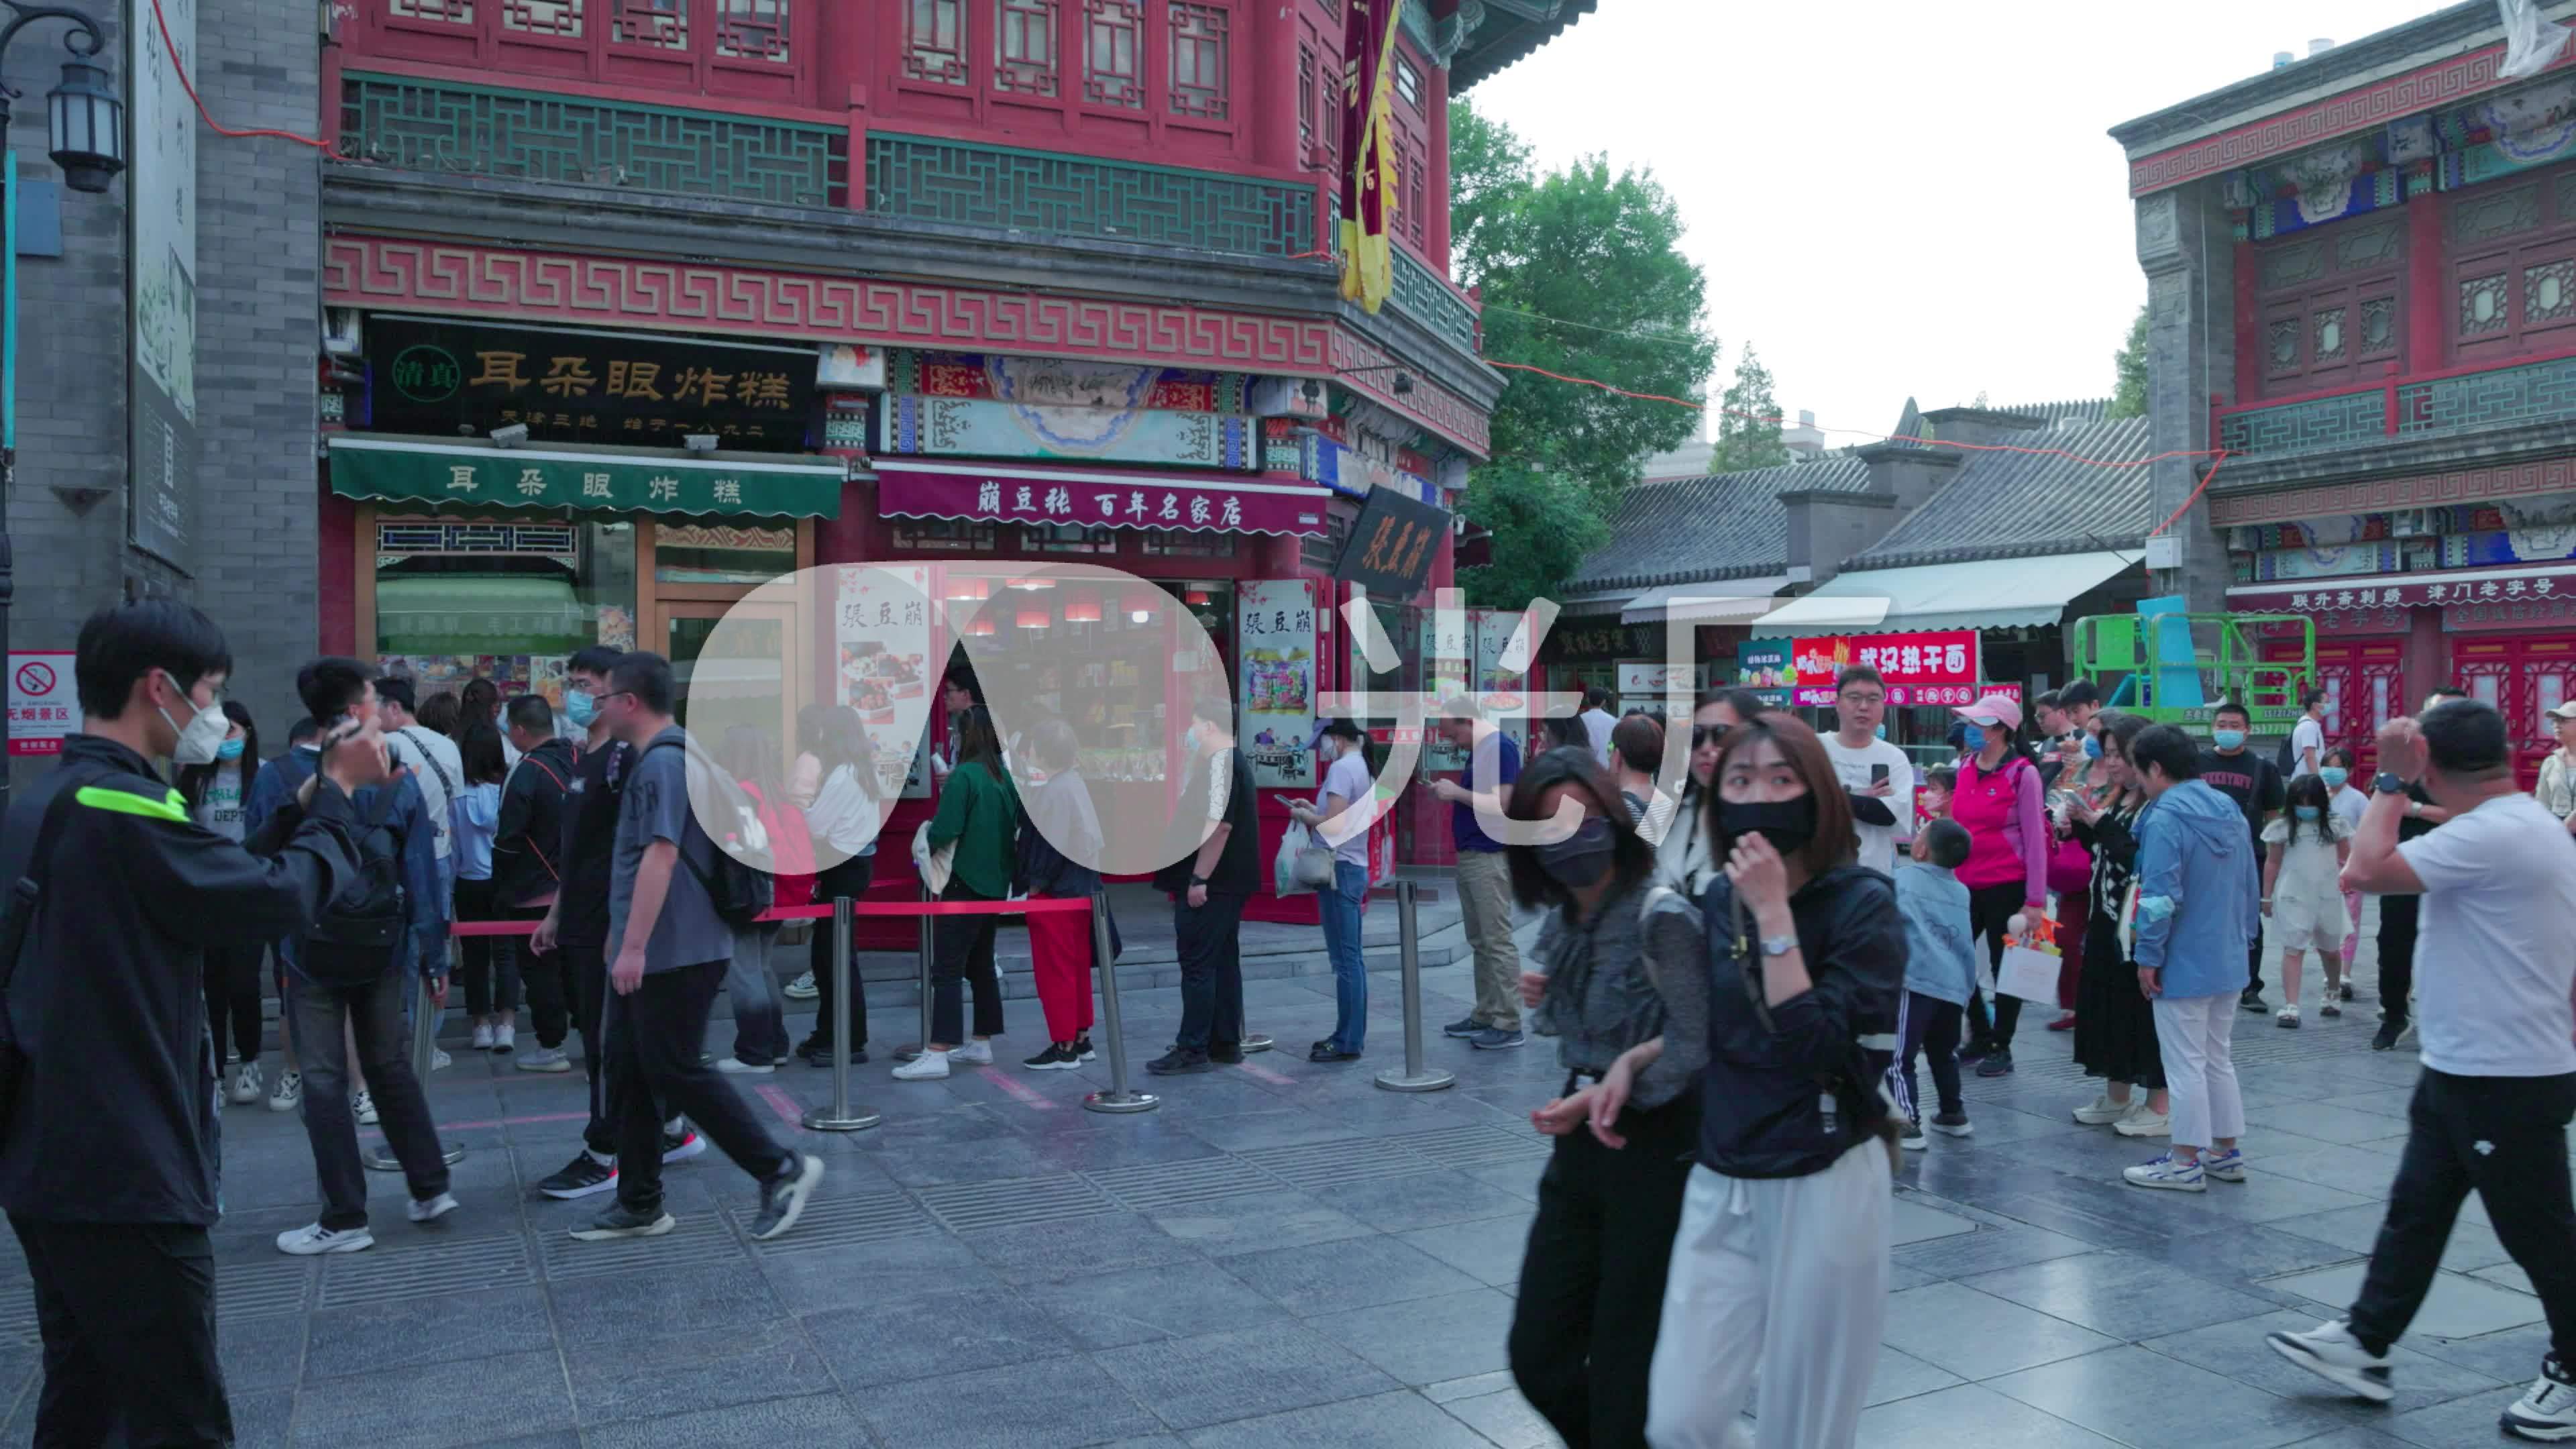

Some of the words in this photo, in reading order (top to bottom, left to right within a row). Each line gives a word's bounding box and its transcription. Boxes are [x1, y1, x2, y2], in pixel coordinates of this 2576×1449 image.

[397, 361, 458, 390] 清真
[470, 350, 791, 410] 耳朵眼炸糕
[446, 466, 742, 505] 耳朵眼炸糕
[1094, 490, 1242, 527] 百年名家店
[2292, 588, 2402, 608] 联升斋刺绣
[2428, 578, 2555, 600] 津门老字号
[1860, 643, 1966, 674] 武汉热干面
